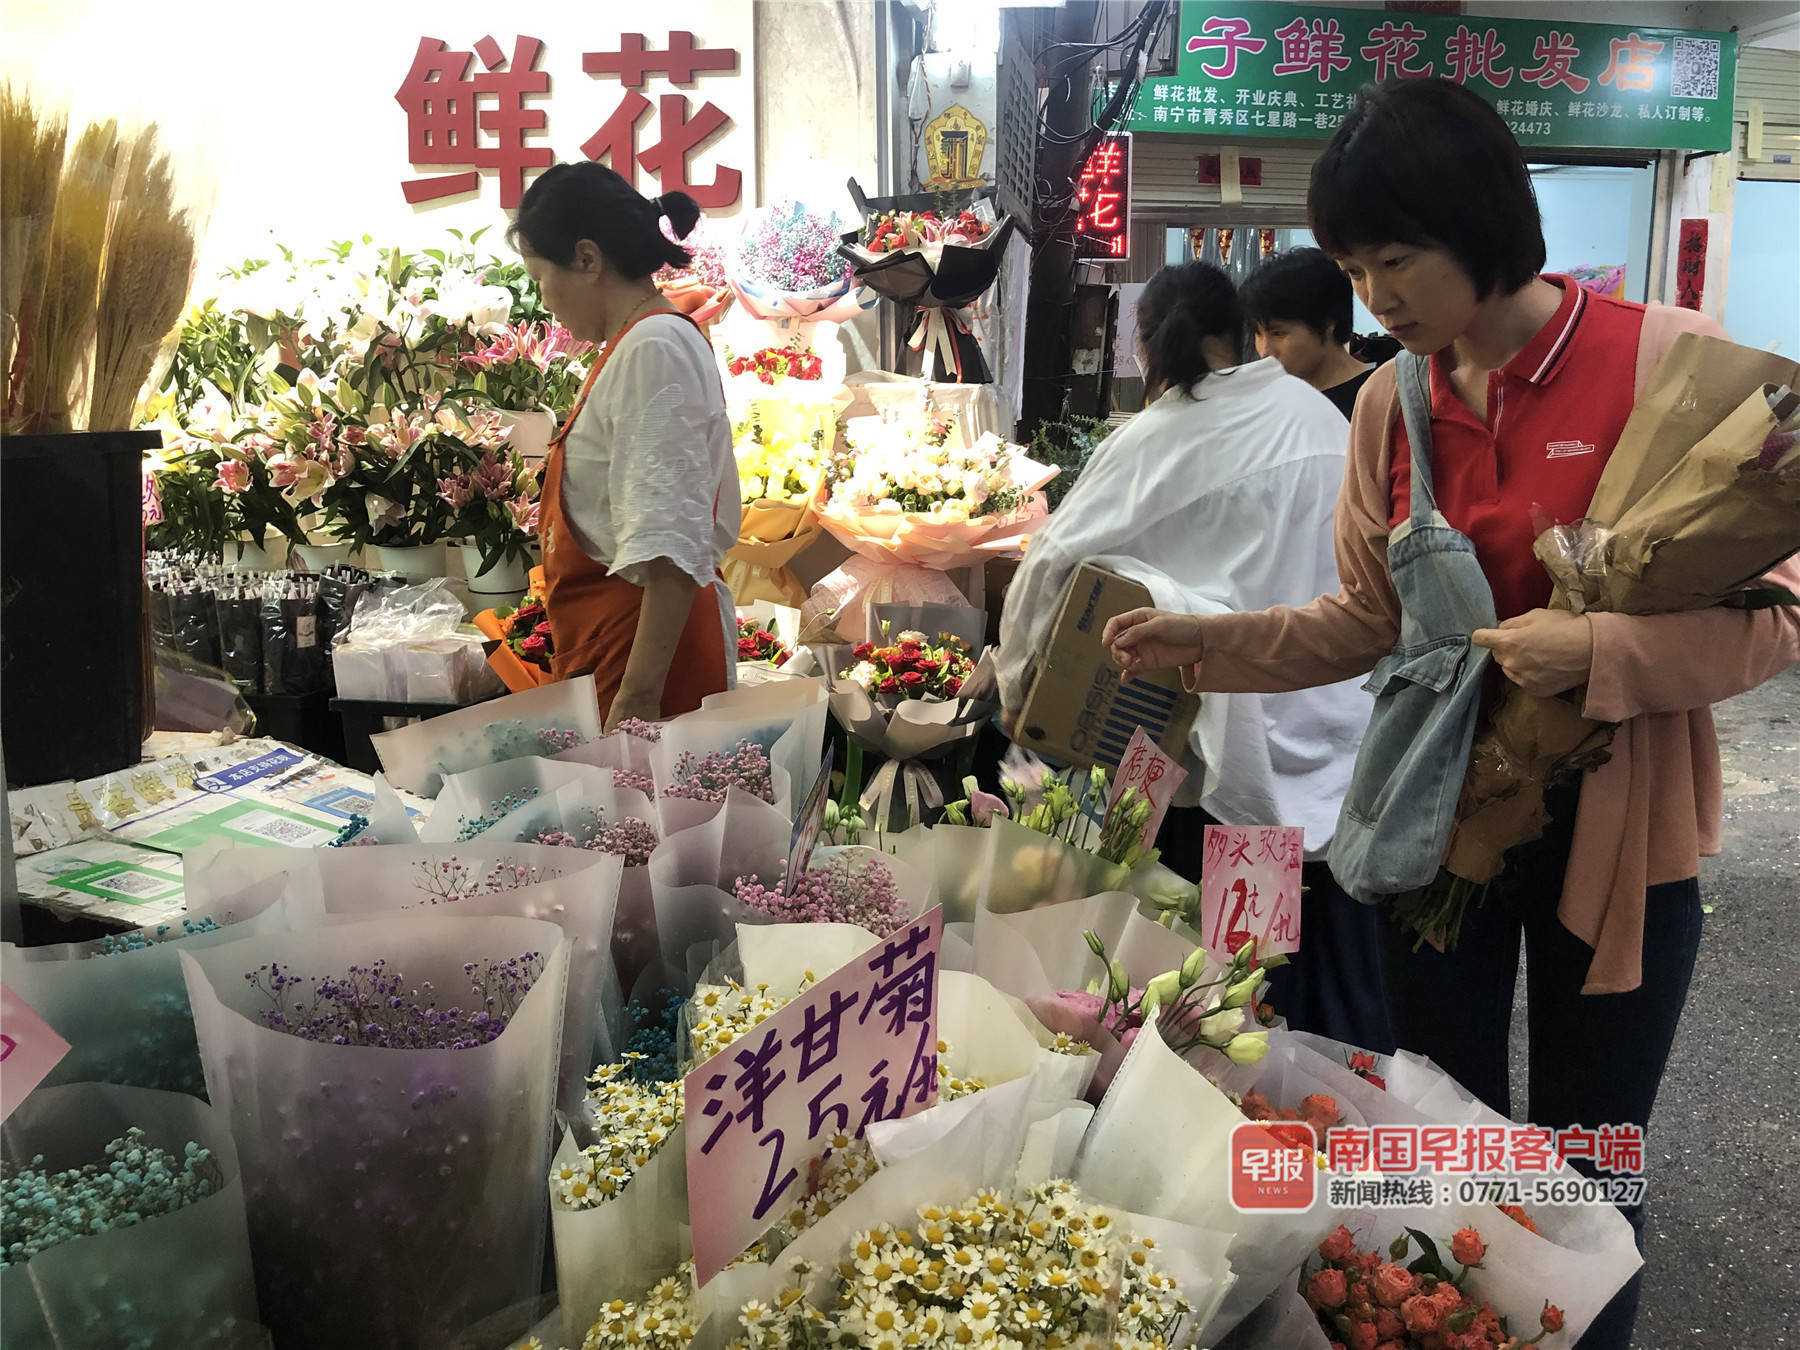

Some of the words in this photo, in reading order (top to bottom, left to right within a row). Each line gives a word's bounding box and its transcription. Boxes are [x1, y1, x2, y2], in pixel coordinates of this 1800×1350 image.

[394, 30, 742, 209] 鲜花
[1186, 15, 1665, 95] 子鲜花批发店
[700, 925, 936, 1156] 洋甘菊
